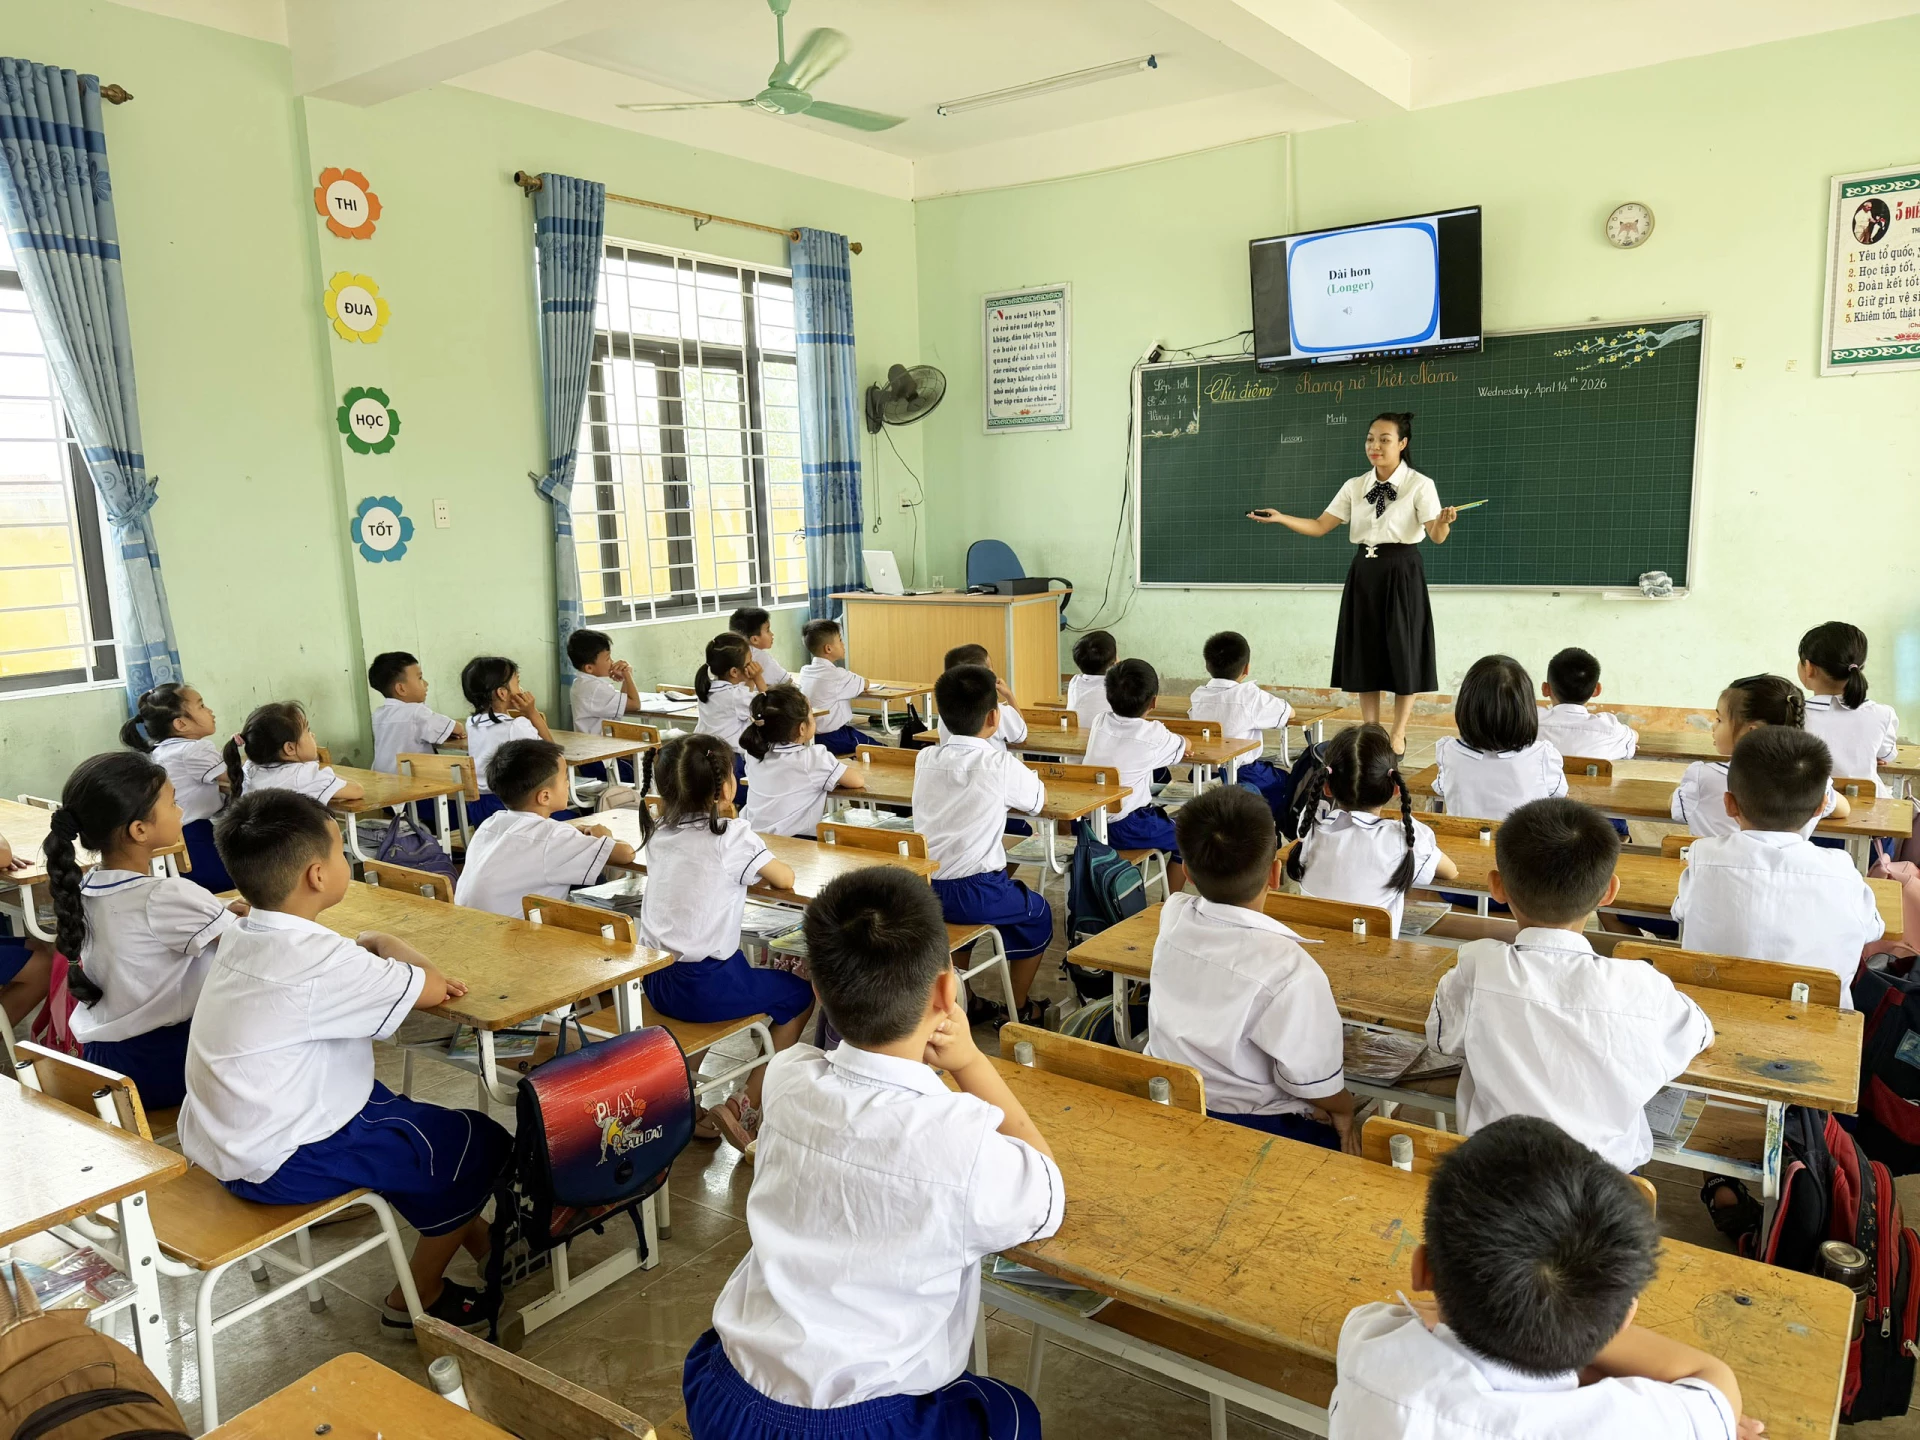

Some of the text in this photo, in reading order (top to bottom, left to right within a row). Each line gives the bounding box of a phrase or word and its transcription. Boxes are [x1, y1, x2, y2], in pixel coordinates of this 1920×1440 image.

[335, 197, 357, 212] THI
[1896, 201, 1904, 222] 5
[1849, 253, 1856, 262] 1.
[1859, 250, 1876, 262] Yêu
[1879, 244, 1888, 259] tổ
[1891, 244, 1915, 260] quốc,
[1328, 267, 1371, 280] Dài hơn
[1848, 260, 1916, 278] 2. Học tập tốt,
[1327, 280, 1374, 297] (Longer)
[1848, 283, 1855, 293] 3.
[1858, 280, 1883, 292] Đoàn
[1887, 276, 1902, 288] kết
[1847, 299, 1855, 308] 4.
[1898, 291, 1910, 305] vệ
[344, 302, 373, 316] ĐUA
[1854, 311, 1880, 322] Khiêm
[1900, 307, 1916, 320] thật
[1410, 360, 1458, 385] Nam
[1478, 385, 1532, 399] Wednesday,
[1534, 382, 1555, 397] April
[1580, 378, 1607, 391] 2026
[1177, 394, 1187, 404] 34
[356, 414, 384, 429] HỌC
[1326, 413, 1347, 424] Math
[1281, 433, 1303, 444] Lesson
[368, 520, 393, 536] TỐT
[597, 1086, 637, 1124] PLAY
[645, 1125, 663, 1143] DAY
